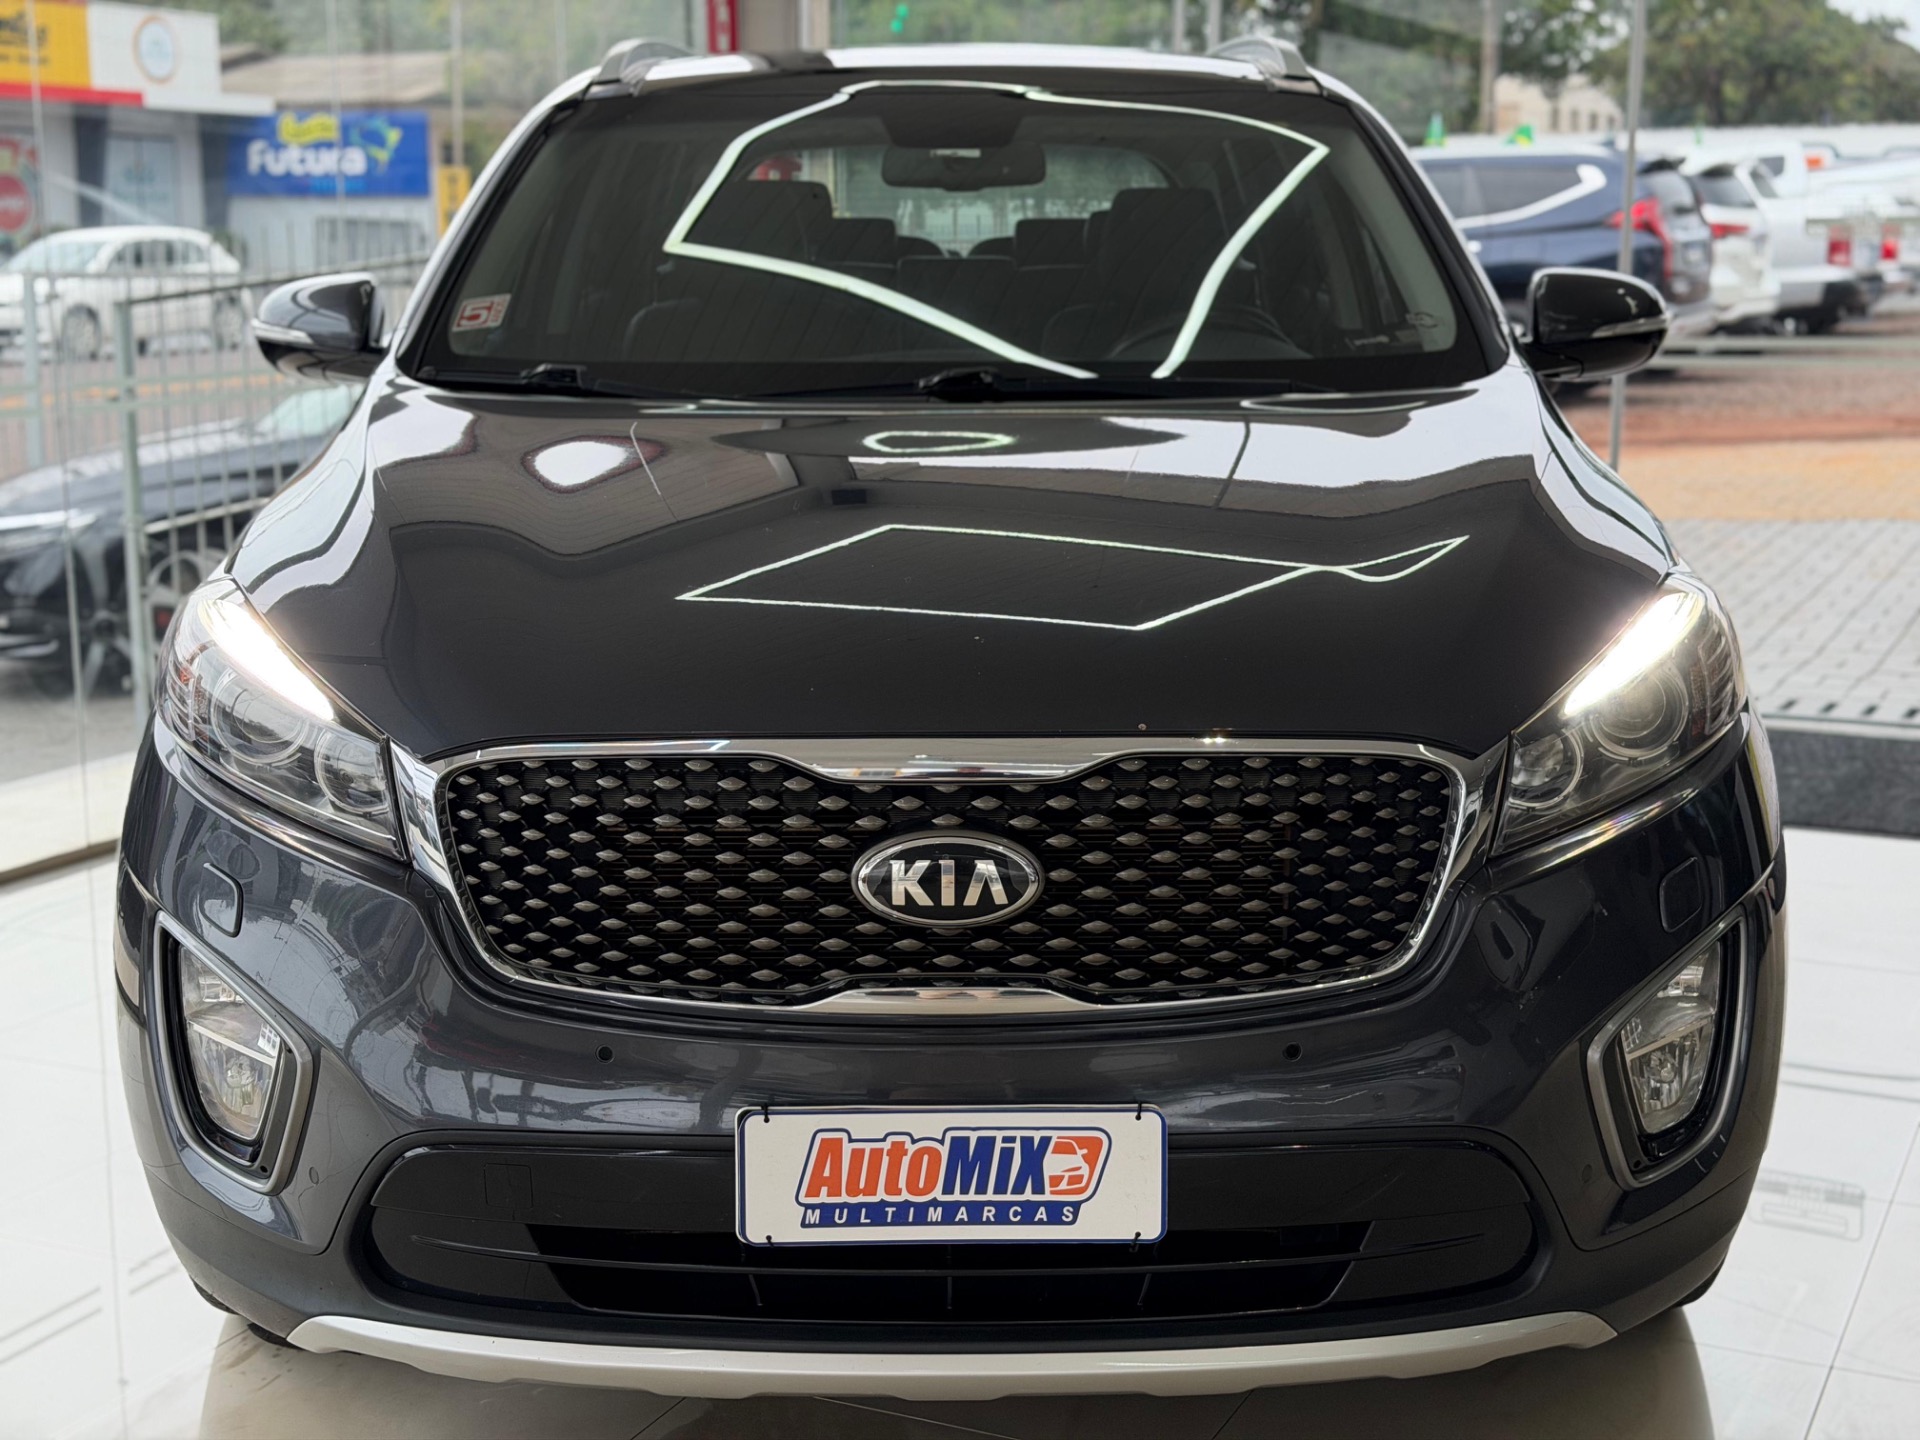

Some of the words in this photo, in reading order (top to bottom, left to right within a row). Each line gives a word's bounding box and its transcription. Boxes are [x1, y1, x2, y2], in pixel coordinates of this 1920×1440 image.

[247, 138, 368, 177] Futura
[889, 859, 1009, 906] KIA
[805, 1206, 1075, 1225] MULTIMARCAS
